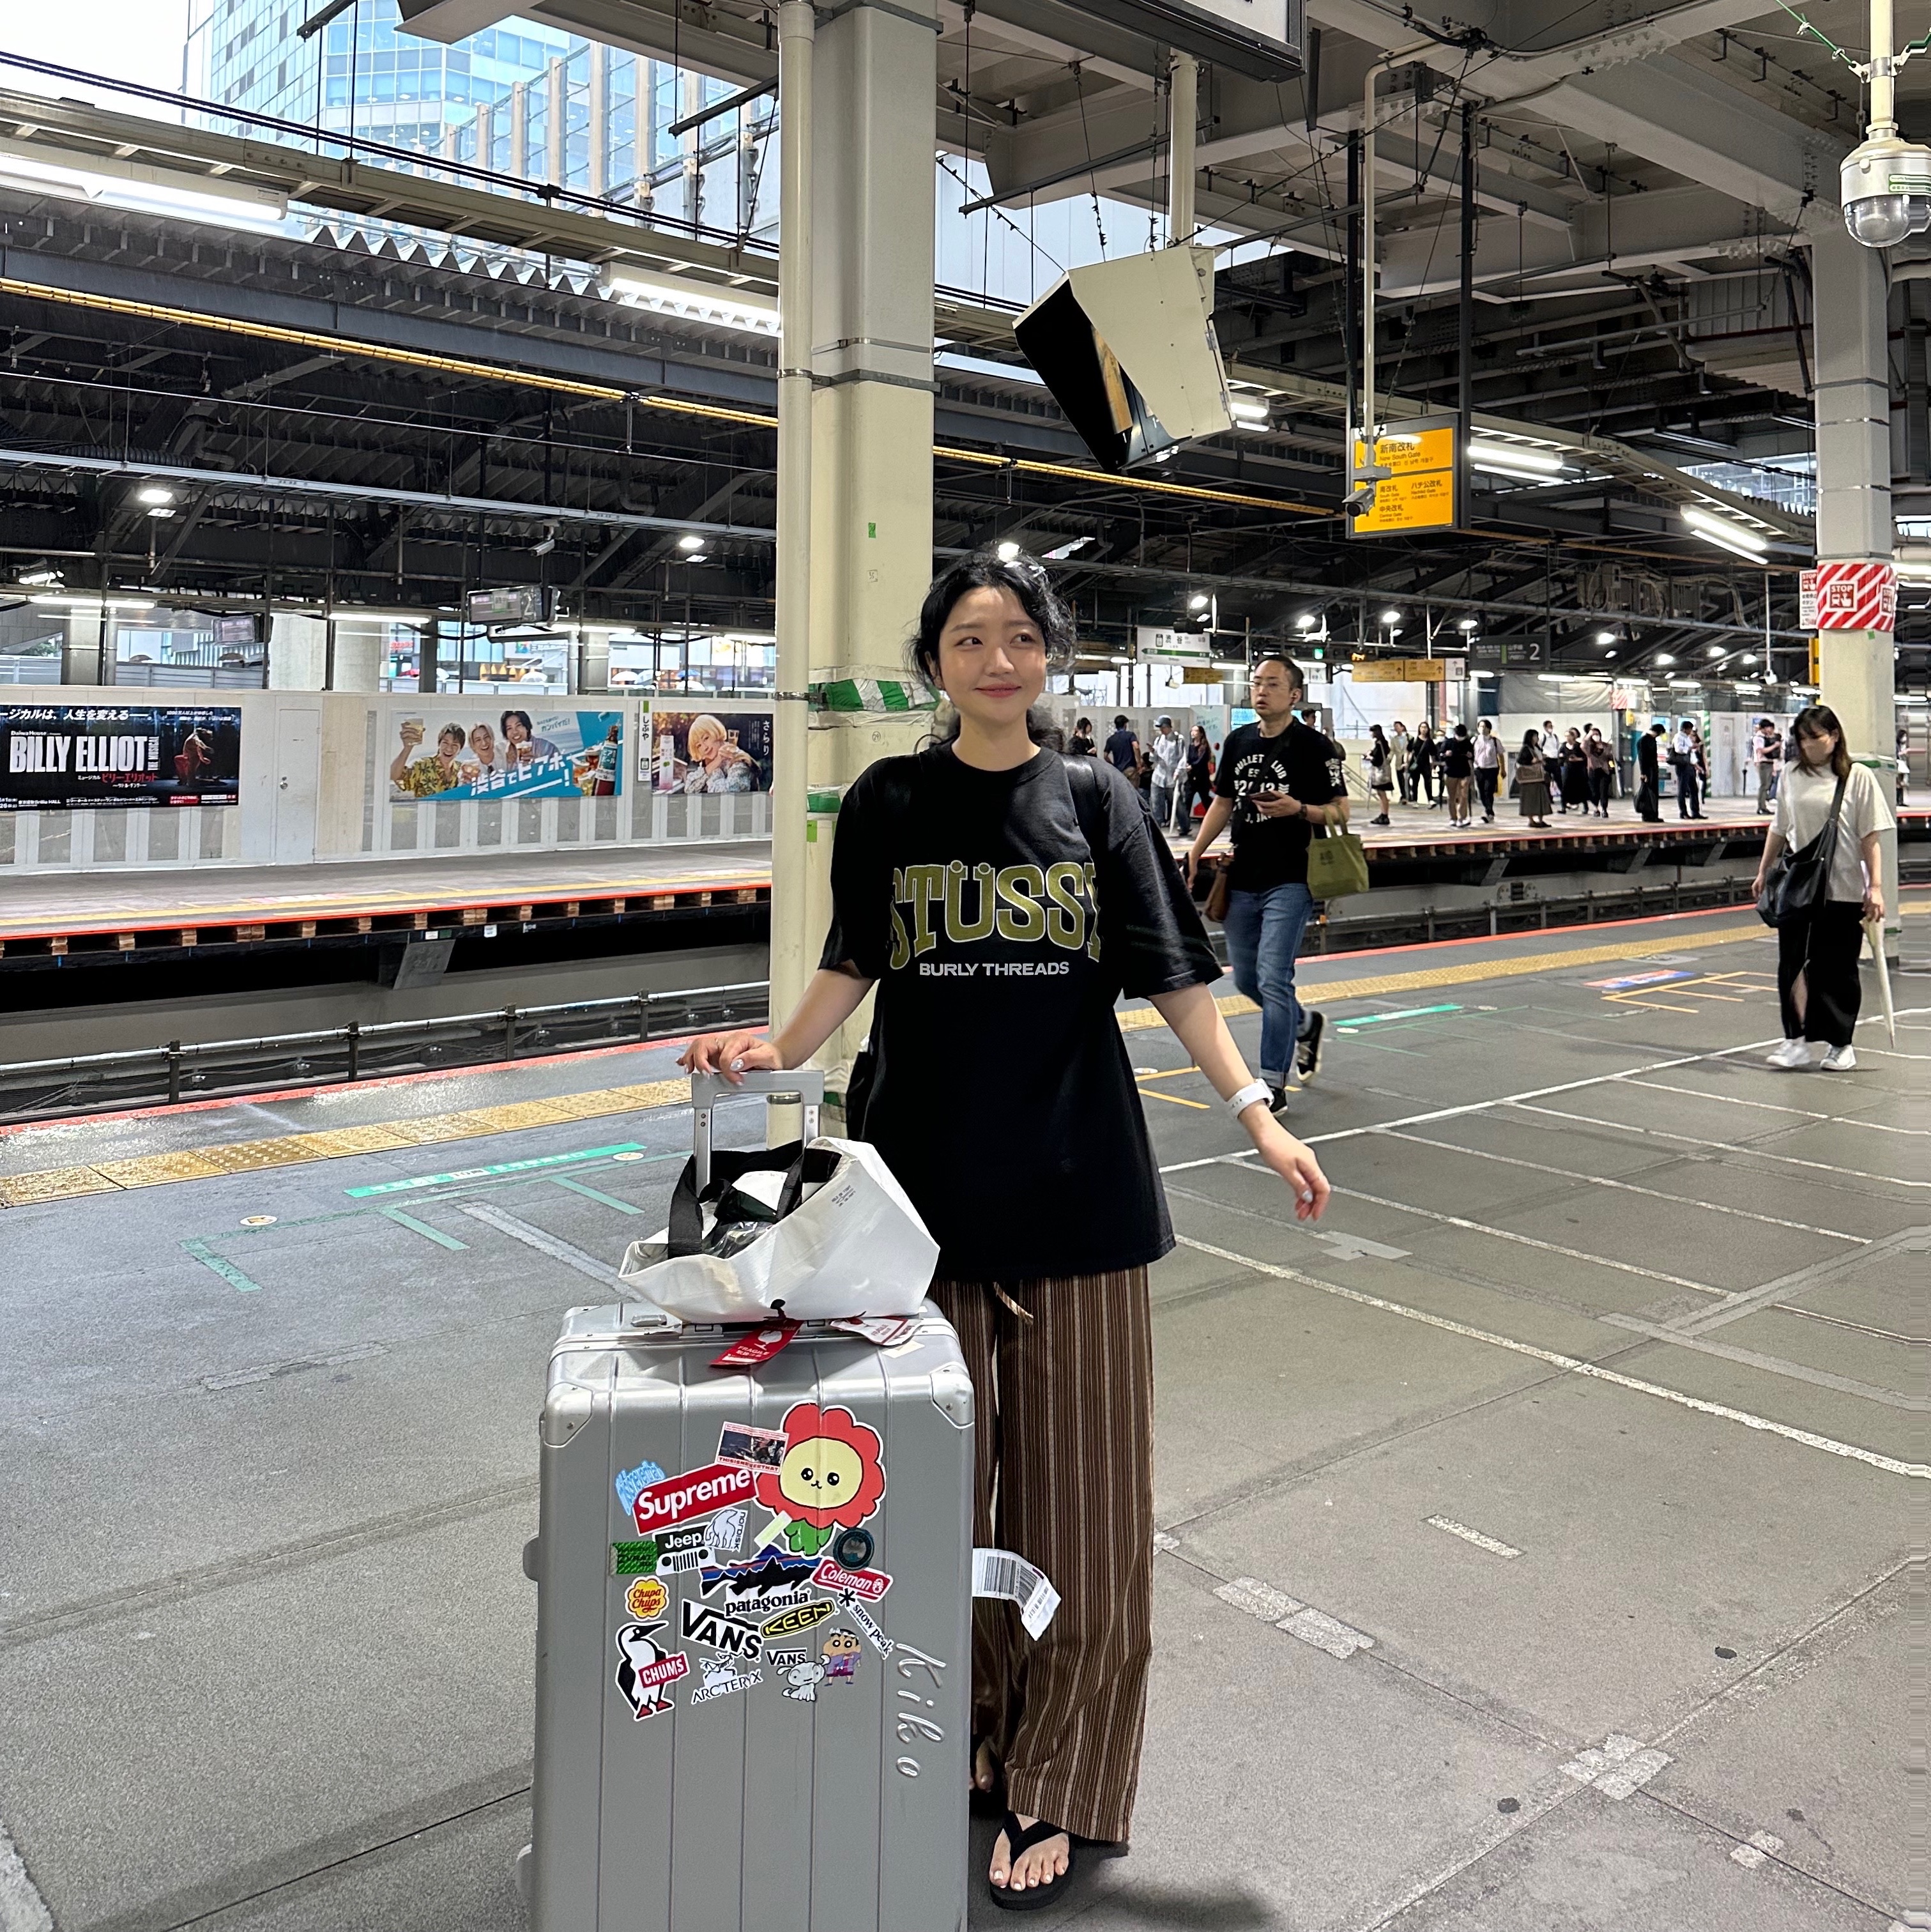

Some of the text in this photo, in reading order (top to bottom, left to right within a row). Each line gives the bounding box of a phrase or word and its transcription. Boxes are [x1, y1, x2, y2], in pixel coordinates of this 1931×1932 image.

[1411, 480, 1443, 489] ハチ公改札
[1529, 643, 1541, 661] 2
[10, 736, 148, 772] BILLY ELLIOT
[148, 736, 159, 770] THE MUSICAL
[1271, 760, 1287, 779] LUB
[920, 962, 1069, 976] BURLY THREADS
[738, 1346, 770, 1355] FRAGILE
[638, 1469, 751, 1519] Supreme
[665, 1533, 701, 1549] Jeep
[821, 1564, 873, 1591] Coleman
[632, 1598, 661, 1613] Chups
[634, 1589, 662, 1599] Chupa
[726, 1591, 809, 1616] patagonia
[683, 1602, 761, 1659] VANS
[765, 1604, 830, 1634] KEEN
[853, 1604, 893, 1654] snow peak
[767, 1649, 807, 1666] VANS
[643, 1658, 683, 1685] CHUMS
[896, 1643, 947, 1777] Kiko
